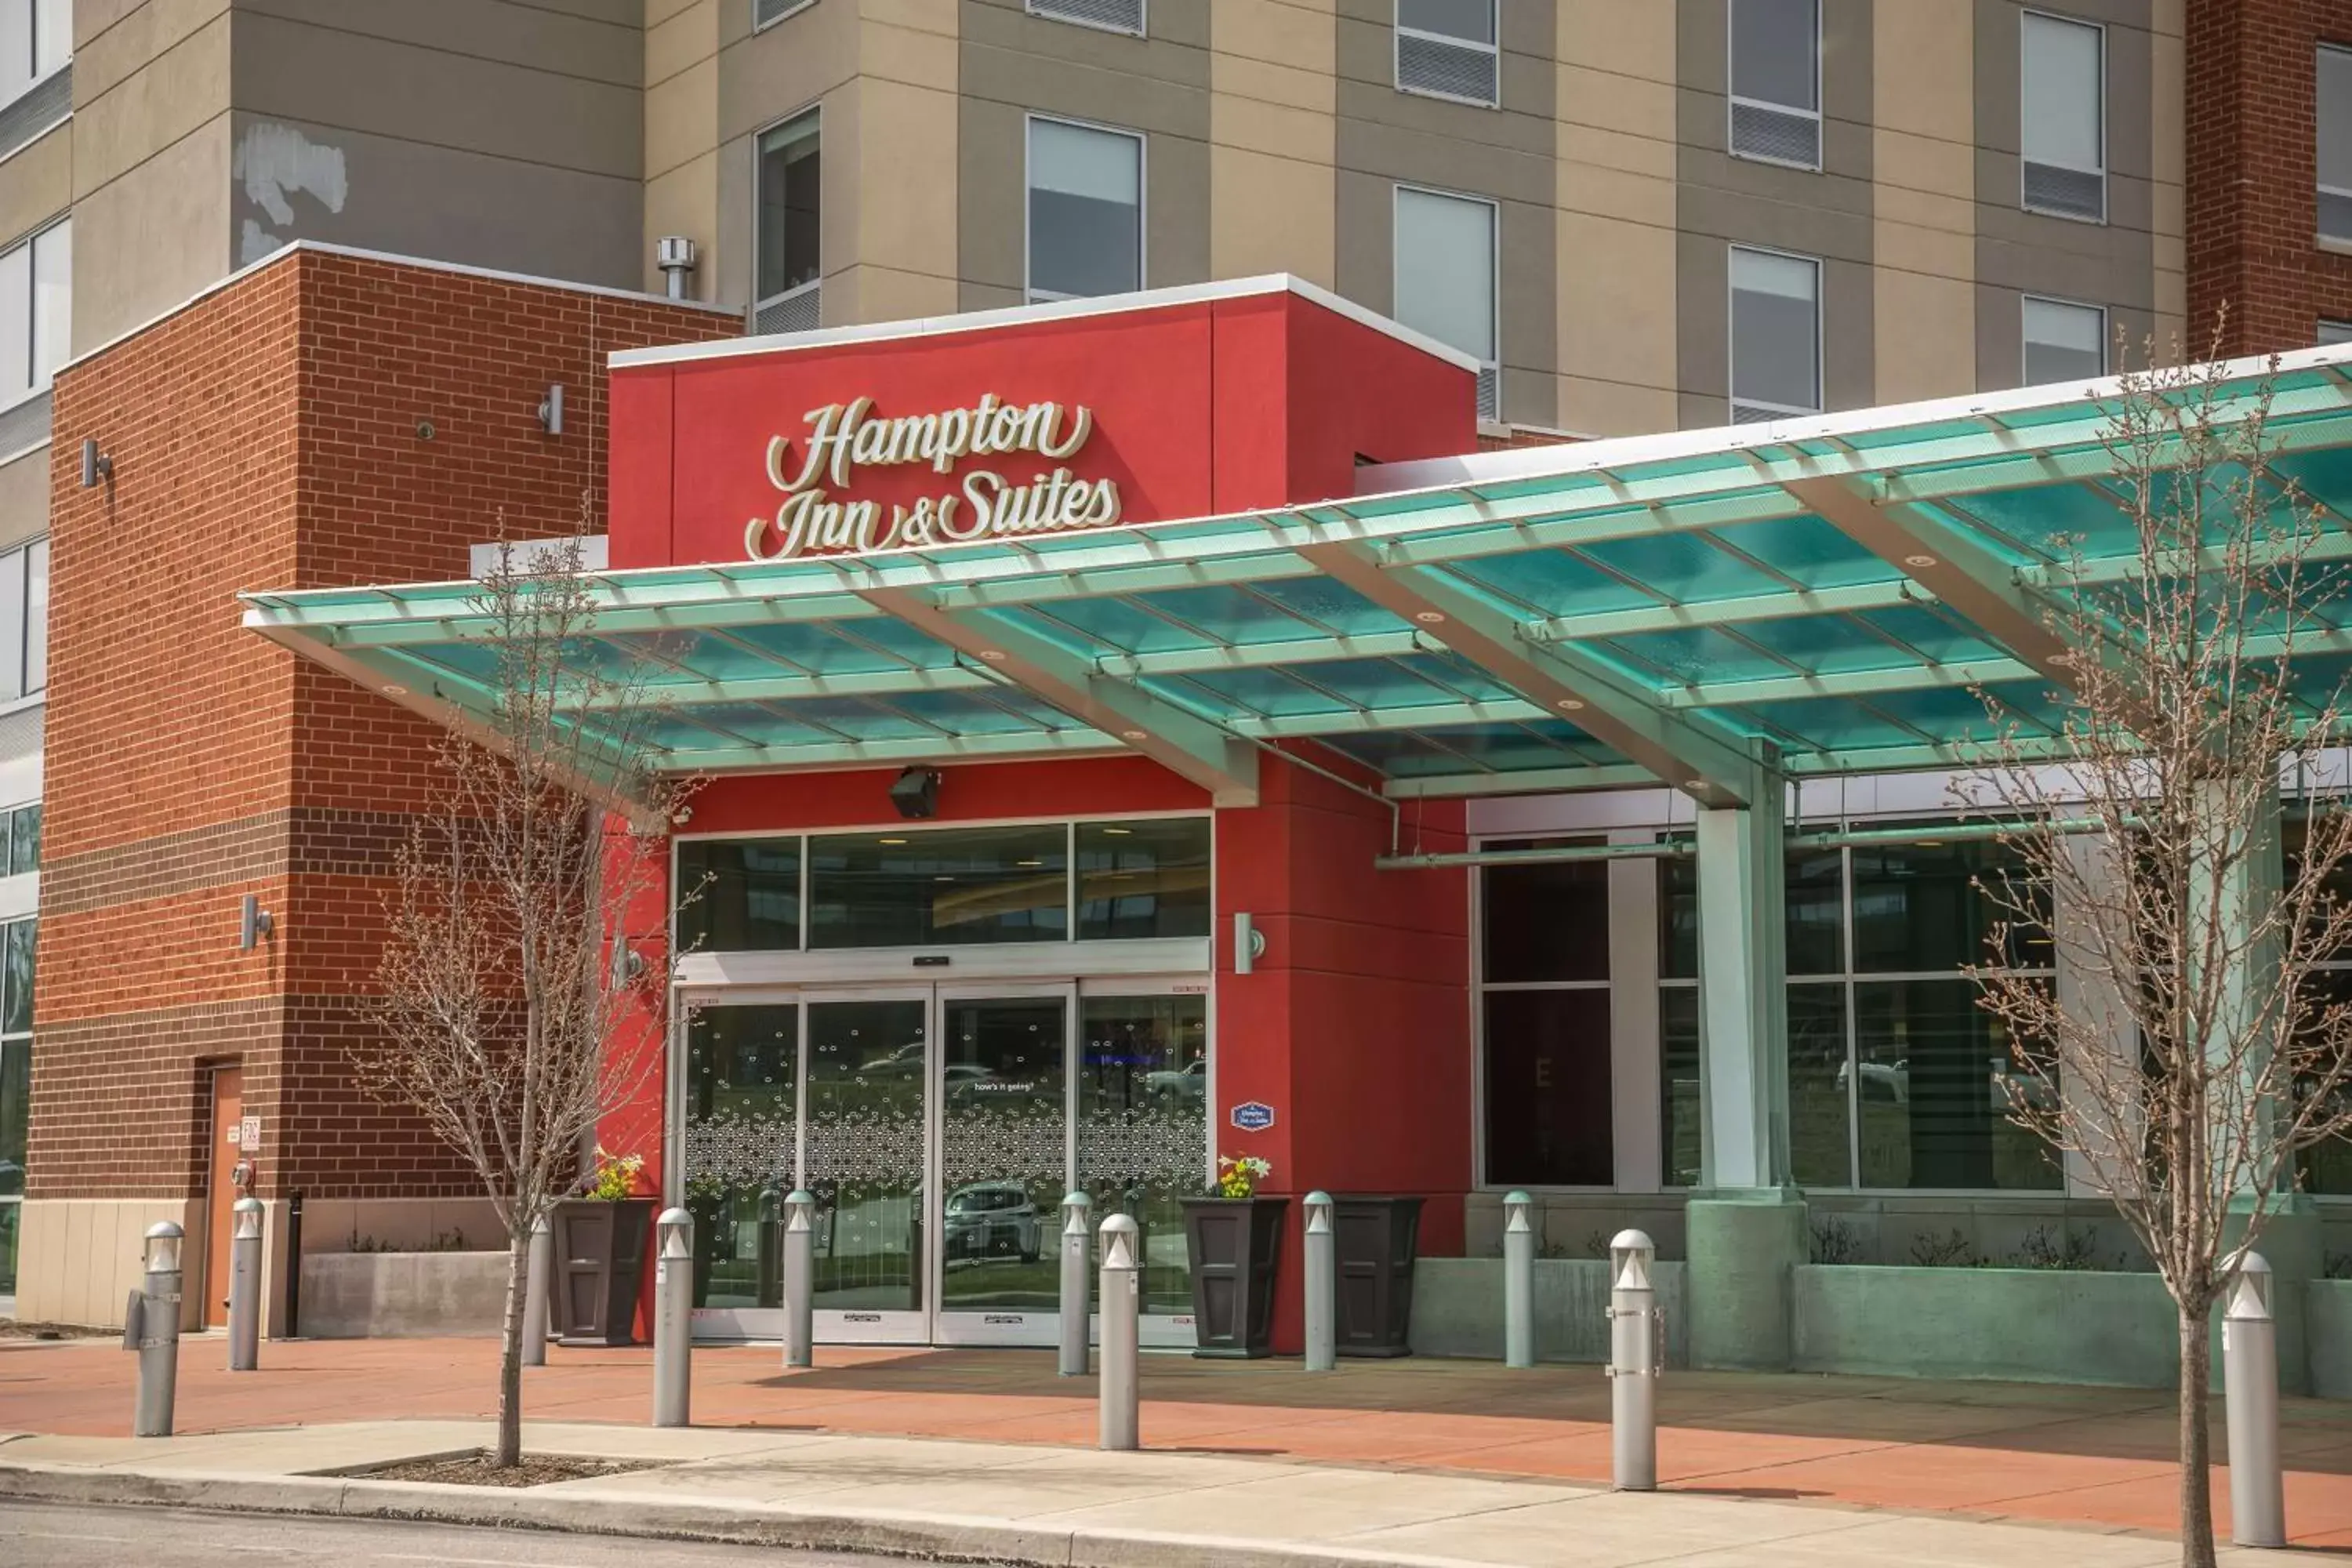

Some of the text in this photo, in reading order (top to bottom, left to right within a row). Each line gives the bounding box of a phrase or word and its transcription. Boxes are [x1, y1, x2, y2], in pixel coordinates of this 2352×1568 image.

[766, 393, 1091, 492] Hampton
[745, 467, 1122, 560] Inn & Suites
